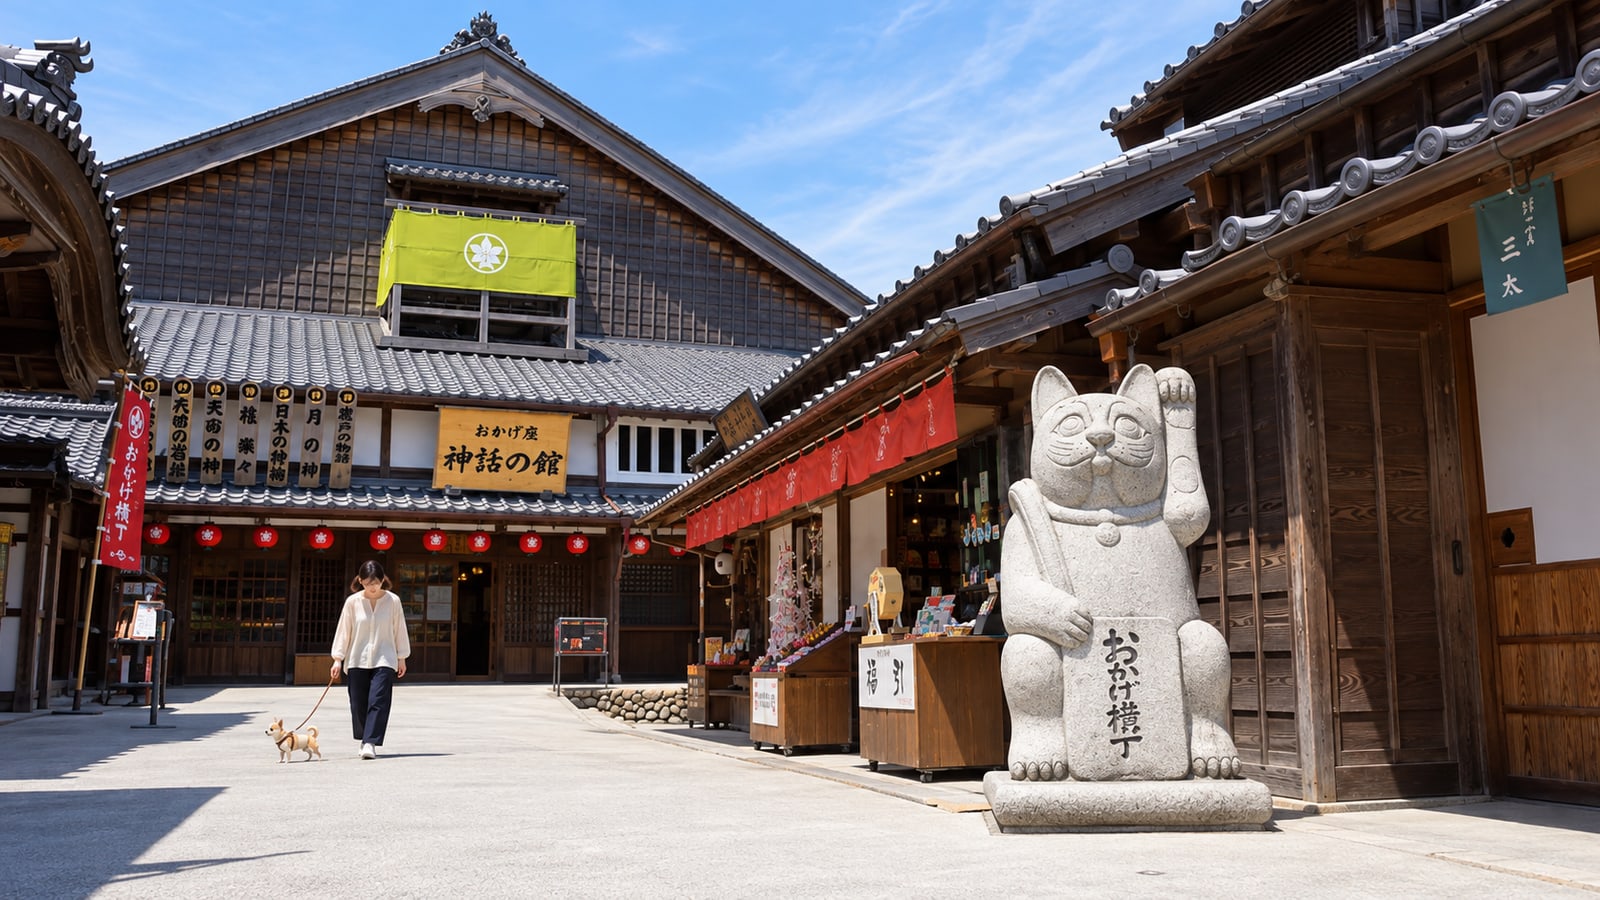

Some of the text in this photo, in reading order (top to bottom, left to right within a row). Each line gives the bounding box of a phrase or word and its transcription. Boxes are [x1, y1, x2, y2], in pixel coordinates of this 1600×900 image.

[1500, 236, 1524, 298] 三太
[301, 408, 322, 479] 月の神
[443, 445, 563, 477] 神話の館
[475, 424, 538, 441] おかげ座
[114, 442, 138, 542] おかげ横丁
[1102, 628, 1143, 759] おかげ横丁
